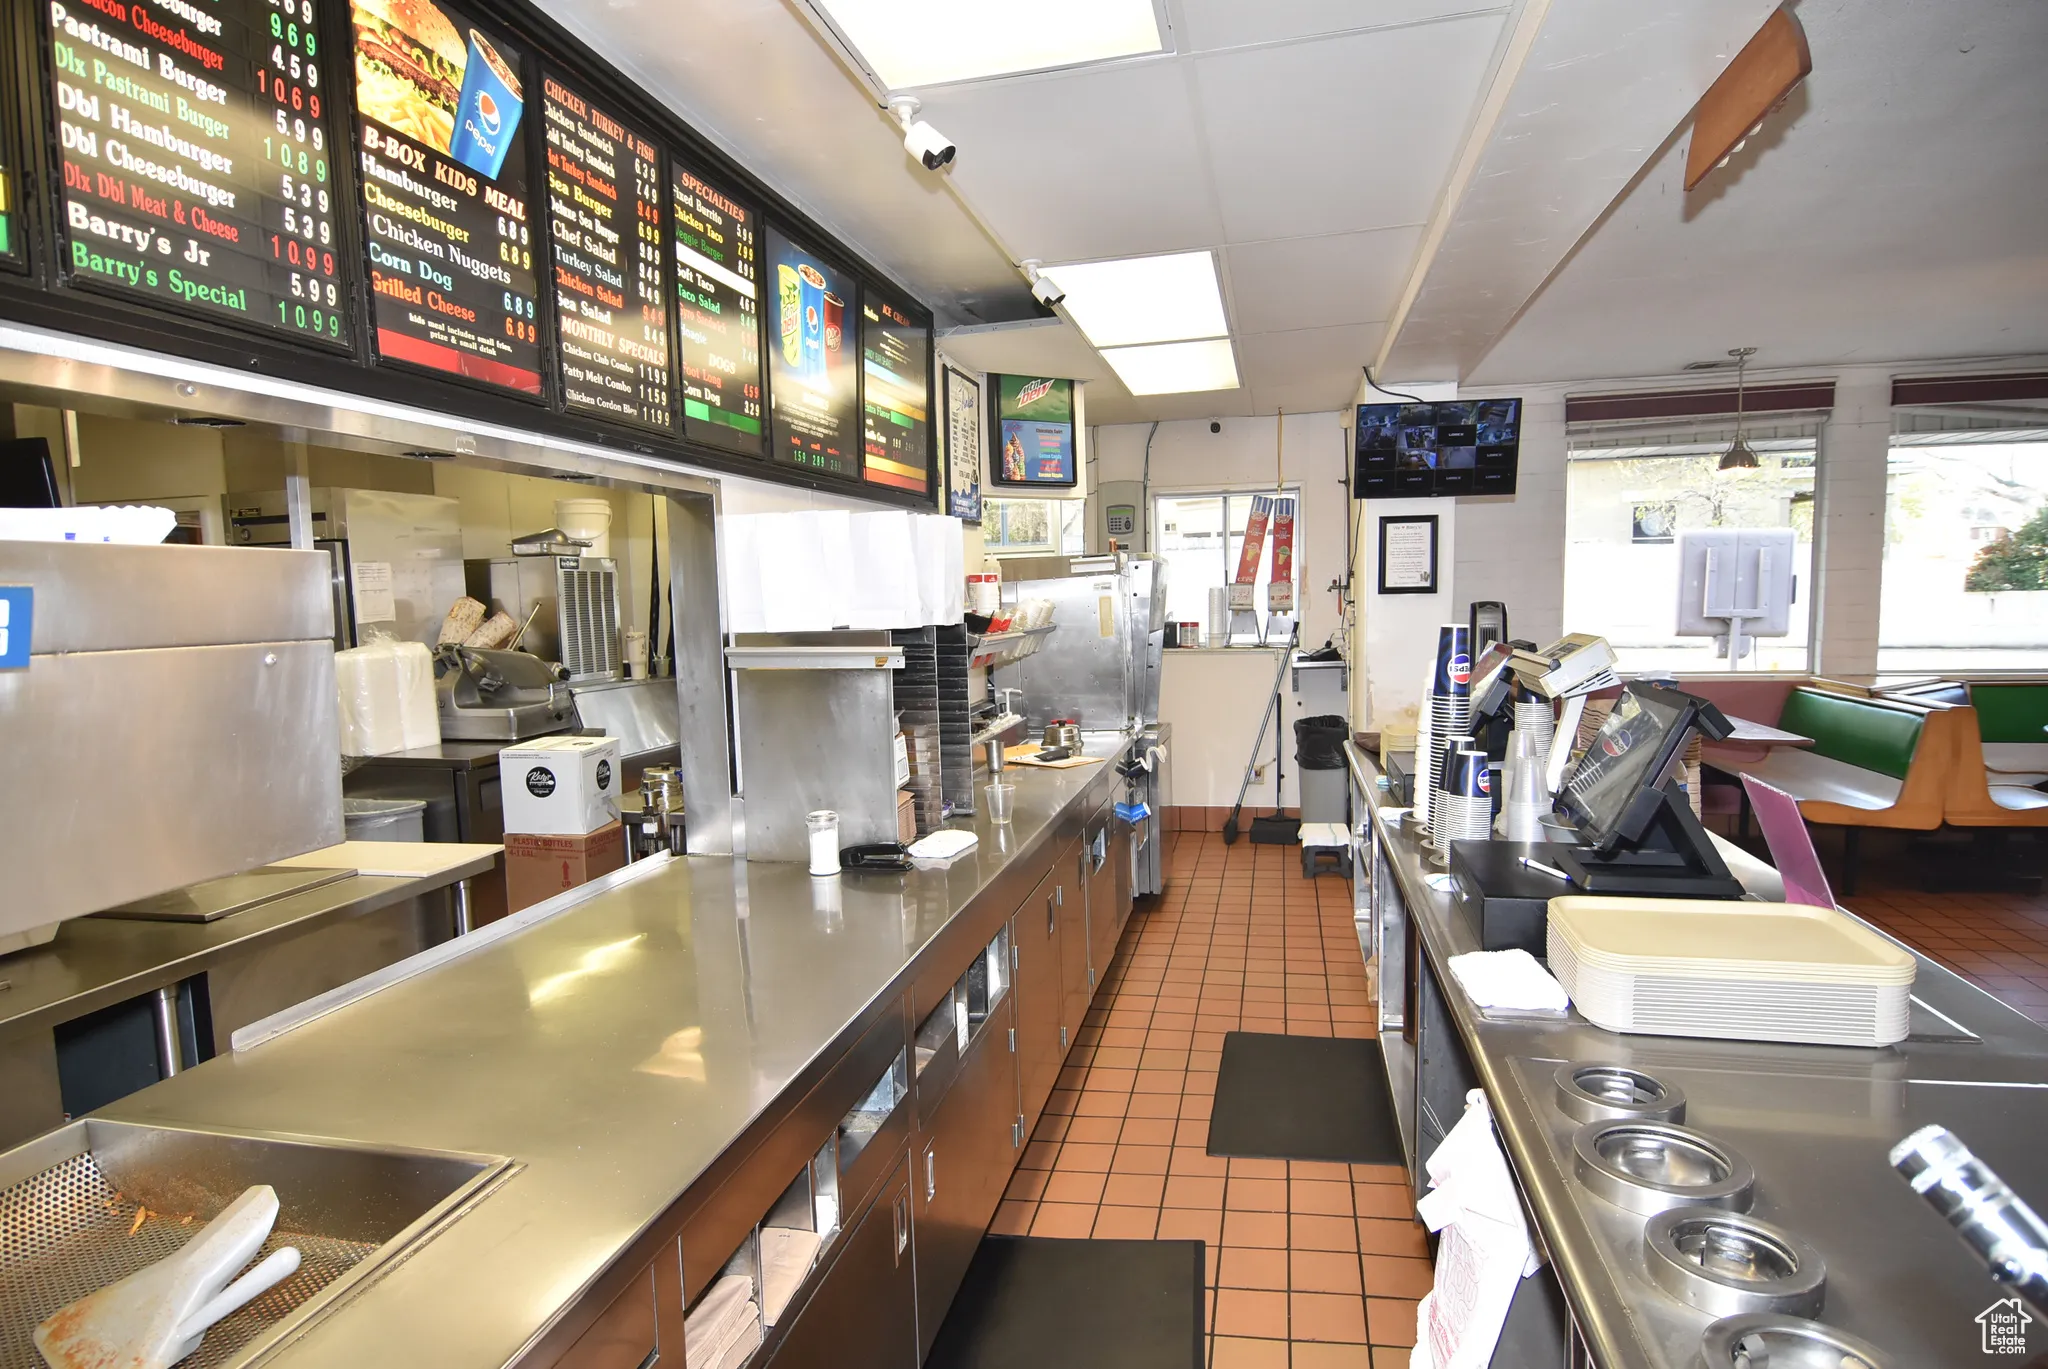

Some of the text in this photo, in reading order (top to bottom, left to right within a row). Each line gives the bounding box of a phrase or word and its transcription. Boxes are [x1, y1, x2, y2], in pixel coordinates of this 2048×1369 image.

[268, 0, 312, 24] .69
[270, 13, 316, 57] 9.69
[51, 1, 323, 150] Pastrami Burger 5.99
[132, 5, 224, 71] Cheeseburger
[257, 69, 320, 118] 10.69
[54, 41, 326, 182] Dlx Pastrami Burger 10.89
[544, 78, 655, 163] CHICKEN, TURKEY & FISH
[57, 81, 329, 214] Dbl Hamburger 5.39
[465, 119, 496, 157] pepsi
[561, 133, 584, 162] Turkey
[586, 148, 616, 179] Sandwich
[577, 121, 614, 157] Sandwich
[61, 121, 331, 244] Dbl Cheeseburger 5.39
[362, 151, 458, 213] Hamburger
[364, 125, 526, 221] B-BOX KIDS MEAL
[560, 154, 585, 184] Turkey
[586, 170, 617, 201] Sandwich
[364, 181, 470, 243] Cheeseburger
[549, 171, 570, 196] Sea
[574, 185, 612, 219] Burger
[681, 172, 745, 223] SPECIALTIES
[696, 198, 723, 225] Burrito
[64, 161, 334, 276] Dlx Dbl Meat & Cheese 10.99
[578, 210, 593, 231] Sea
[594, 218, 619, 244] Burger
[706, 223, 724, 244] Taco
[67, 200, 337, 307] Barry's Jr 5.99
[373, 213, 512, 285] Chicken Nuggets
[552, 219, 582, 247] Chef
[584, 235, 616, 265] Salad
[701, 239, 724, 262] Burger
[369, 242, 412, 274] Corn
[418, 260, 453, 292] Dog
[554, 244, 592, 276] Turkey
[594, 264, 623, 289] Salad
[556, 266, 594, 297] Chicken
[596, 285, 623, 309] Salad
[677, 262, 715, 293] Soft Taco
[72, 240, 339, 338] Barry's Special 10.99
[372, 270, 422, 306] Grilled
[427, 291, 476, 323] Cheese
[557, 290, 577, 312] Sea
[580, 300, 612, 326] Salad
[678, 283, 721, 315] Taco Salad
[409, 312, 426, 326] kids
[428, 320, 445, 333] meal
[448, 324, 475, 341] includes
[478, 335, 495, 347] small
[430, 330, 497, 356] prize & small drink
[561, 315, 665, 367] MONTHLY SPECIALS
[562, 341, 592, 360] Chicken
[593, 352, 609, 366] Club
[610, 358, 634, 374] Combo
[563, 362, 584, 382] Patty
[585, 369, 603, 385] Melt
[605, 376, 632, 394] Combo
[682, 361, 722, 389] Foot Long
[709, 353, 736, 375] DOGS
[565, 389, 595, 405] Chicken
[597, 396, 622, 412] Cordon
[684, 380, 721, 407] Corn Dog
[1021, 383, 1052, 405] DEW
[1450, 663, 1470, 673] EPSI
[513, 837, 573, 848] PLASTIC BOTTLES
[562, 880, 571, 888] UP
